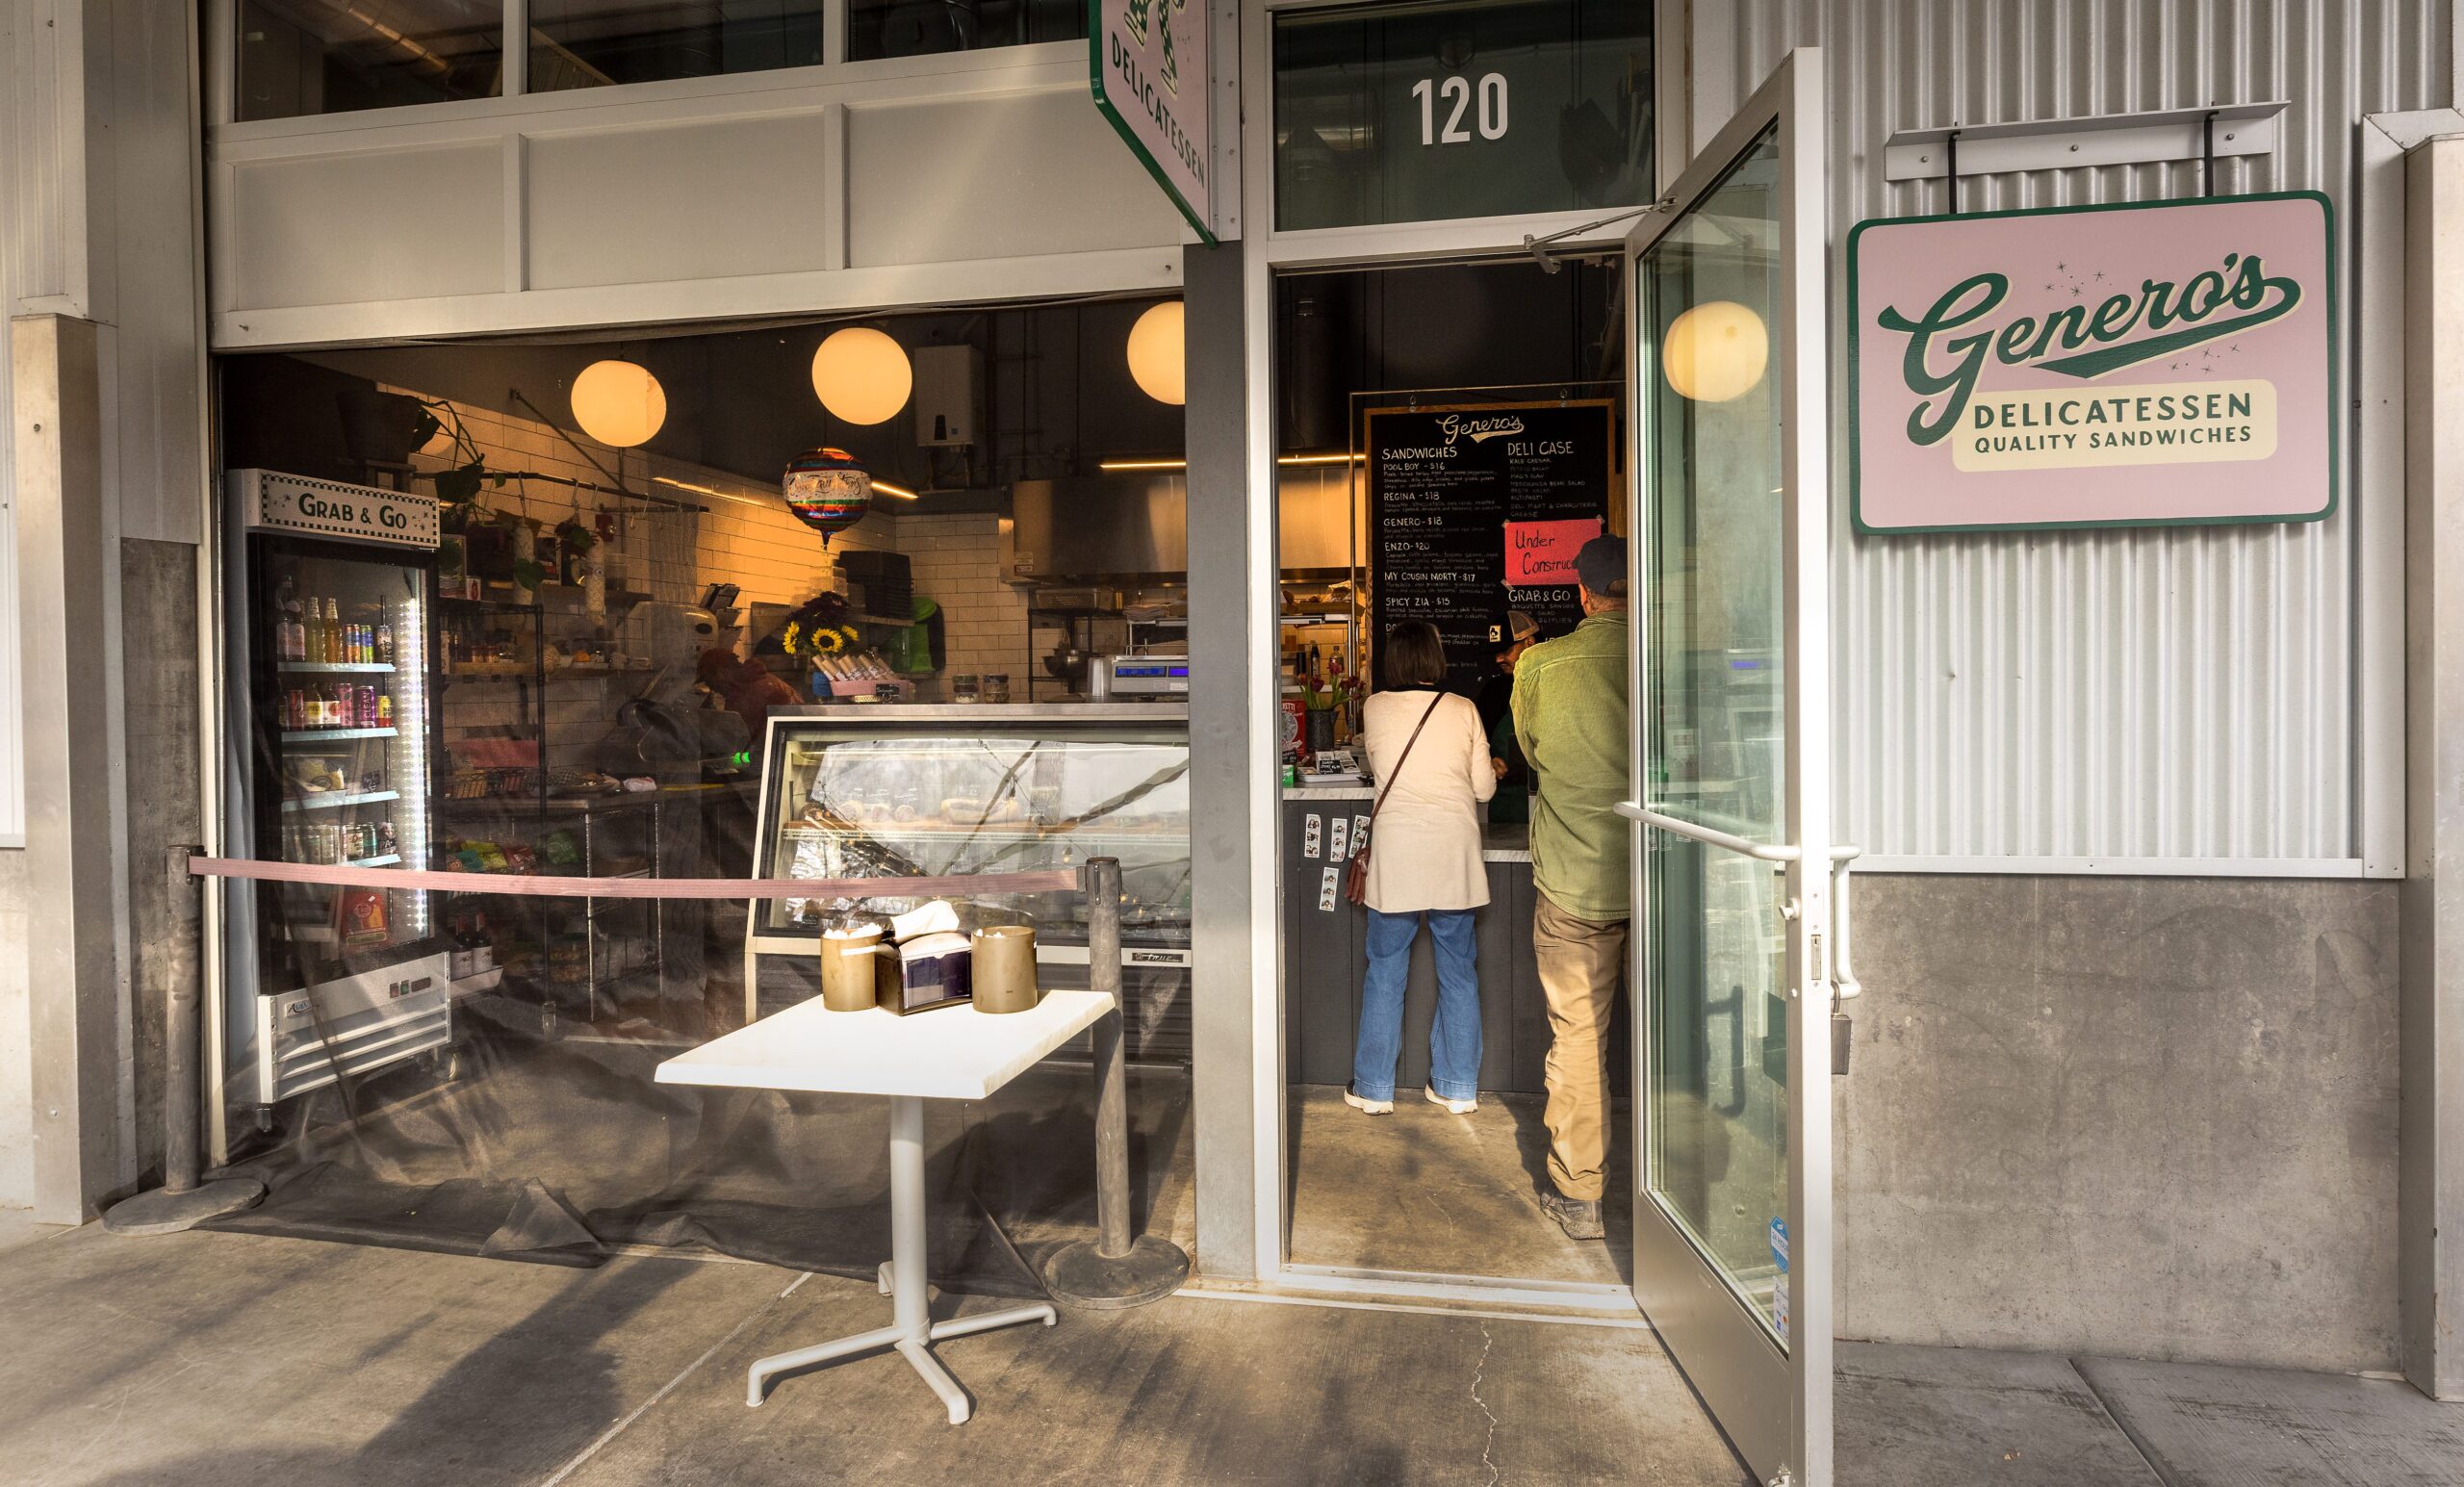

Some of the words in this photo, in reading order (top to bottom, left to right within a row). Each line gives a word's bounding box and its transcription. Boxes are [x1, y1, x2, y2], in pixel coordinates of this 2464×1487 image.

[1112, 31, 1205, 189] DELICATESSEN
[1412, 72, 1508, 145] 120
[1878, 253, 2301, 446] Genero's
[1974, 393, 2251, 429] DELICATESSEN
[1435, 415, 1525, 444] Genero's
[1975, 433, 2077, 453] QUALITY
[2089, 425, 2251, 449] SANDWICHES
[1381, 447, 1458, 460] SANDWICHES
[1507, 442, 1533, 456] DELI
[1538, 441, 1575, 455] CASE
[1383, 463, 1403, 472] POOL
[1404, 462, 1420, 471] BOY
[1383, 492, 1416, 501] REGINA
[360, 507, 372, 525] &
[1515, 529, 1555, 550] Under
[1523, 551, 1573, 575] Construc
[1384, 572, 1398, 580] MY
[1430, 572, 1457, 580] MORTY
[1385, 597, 1410, 606] SPICY
[1415, 597, 1430, 606] ZIA
[1508, 589, 1541, 602] GRAB
[1543, 590, 1551, 602] &
[1552, 589, 1571, 602] GO
